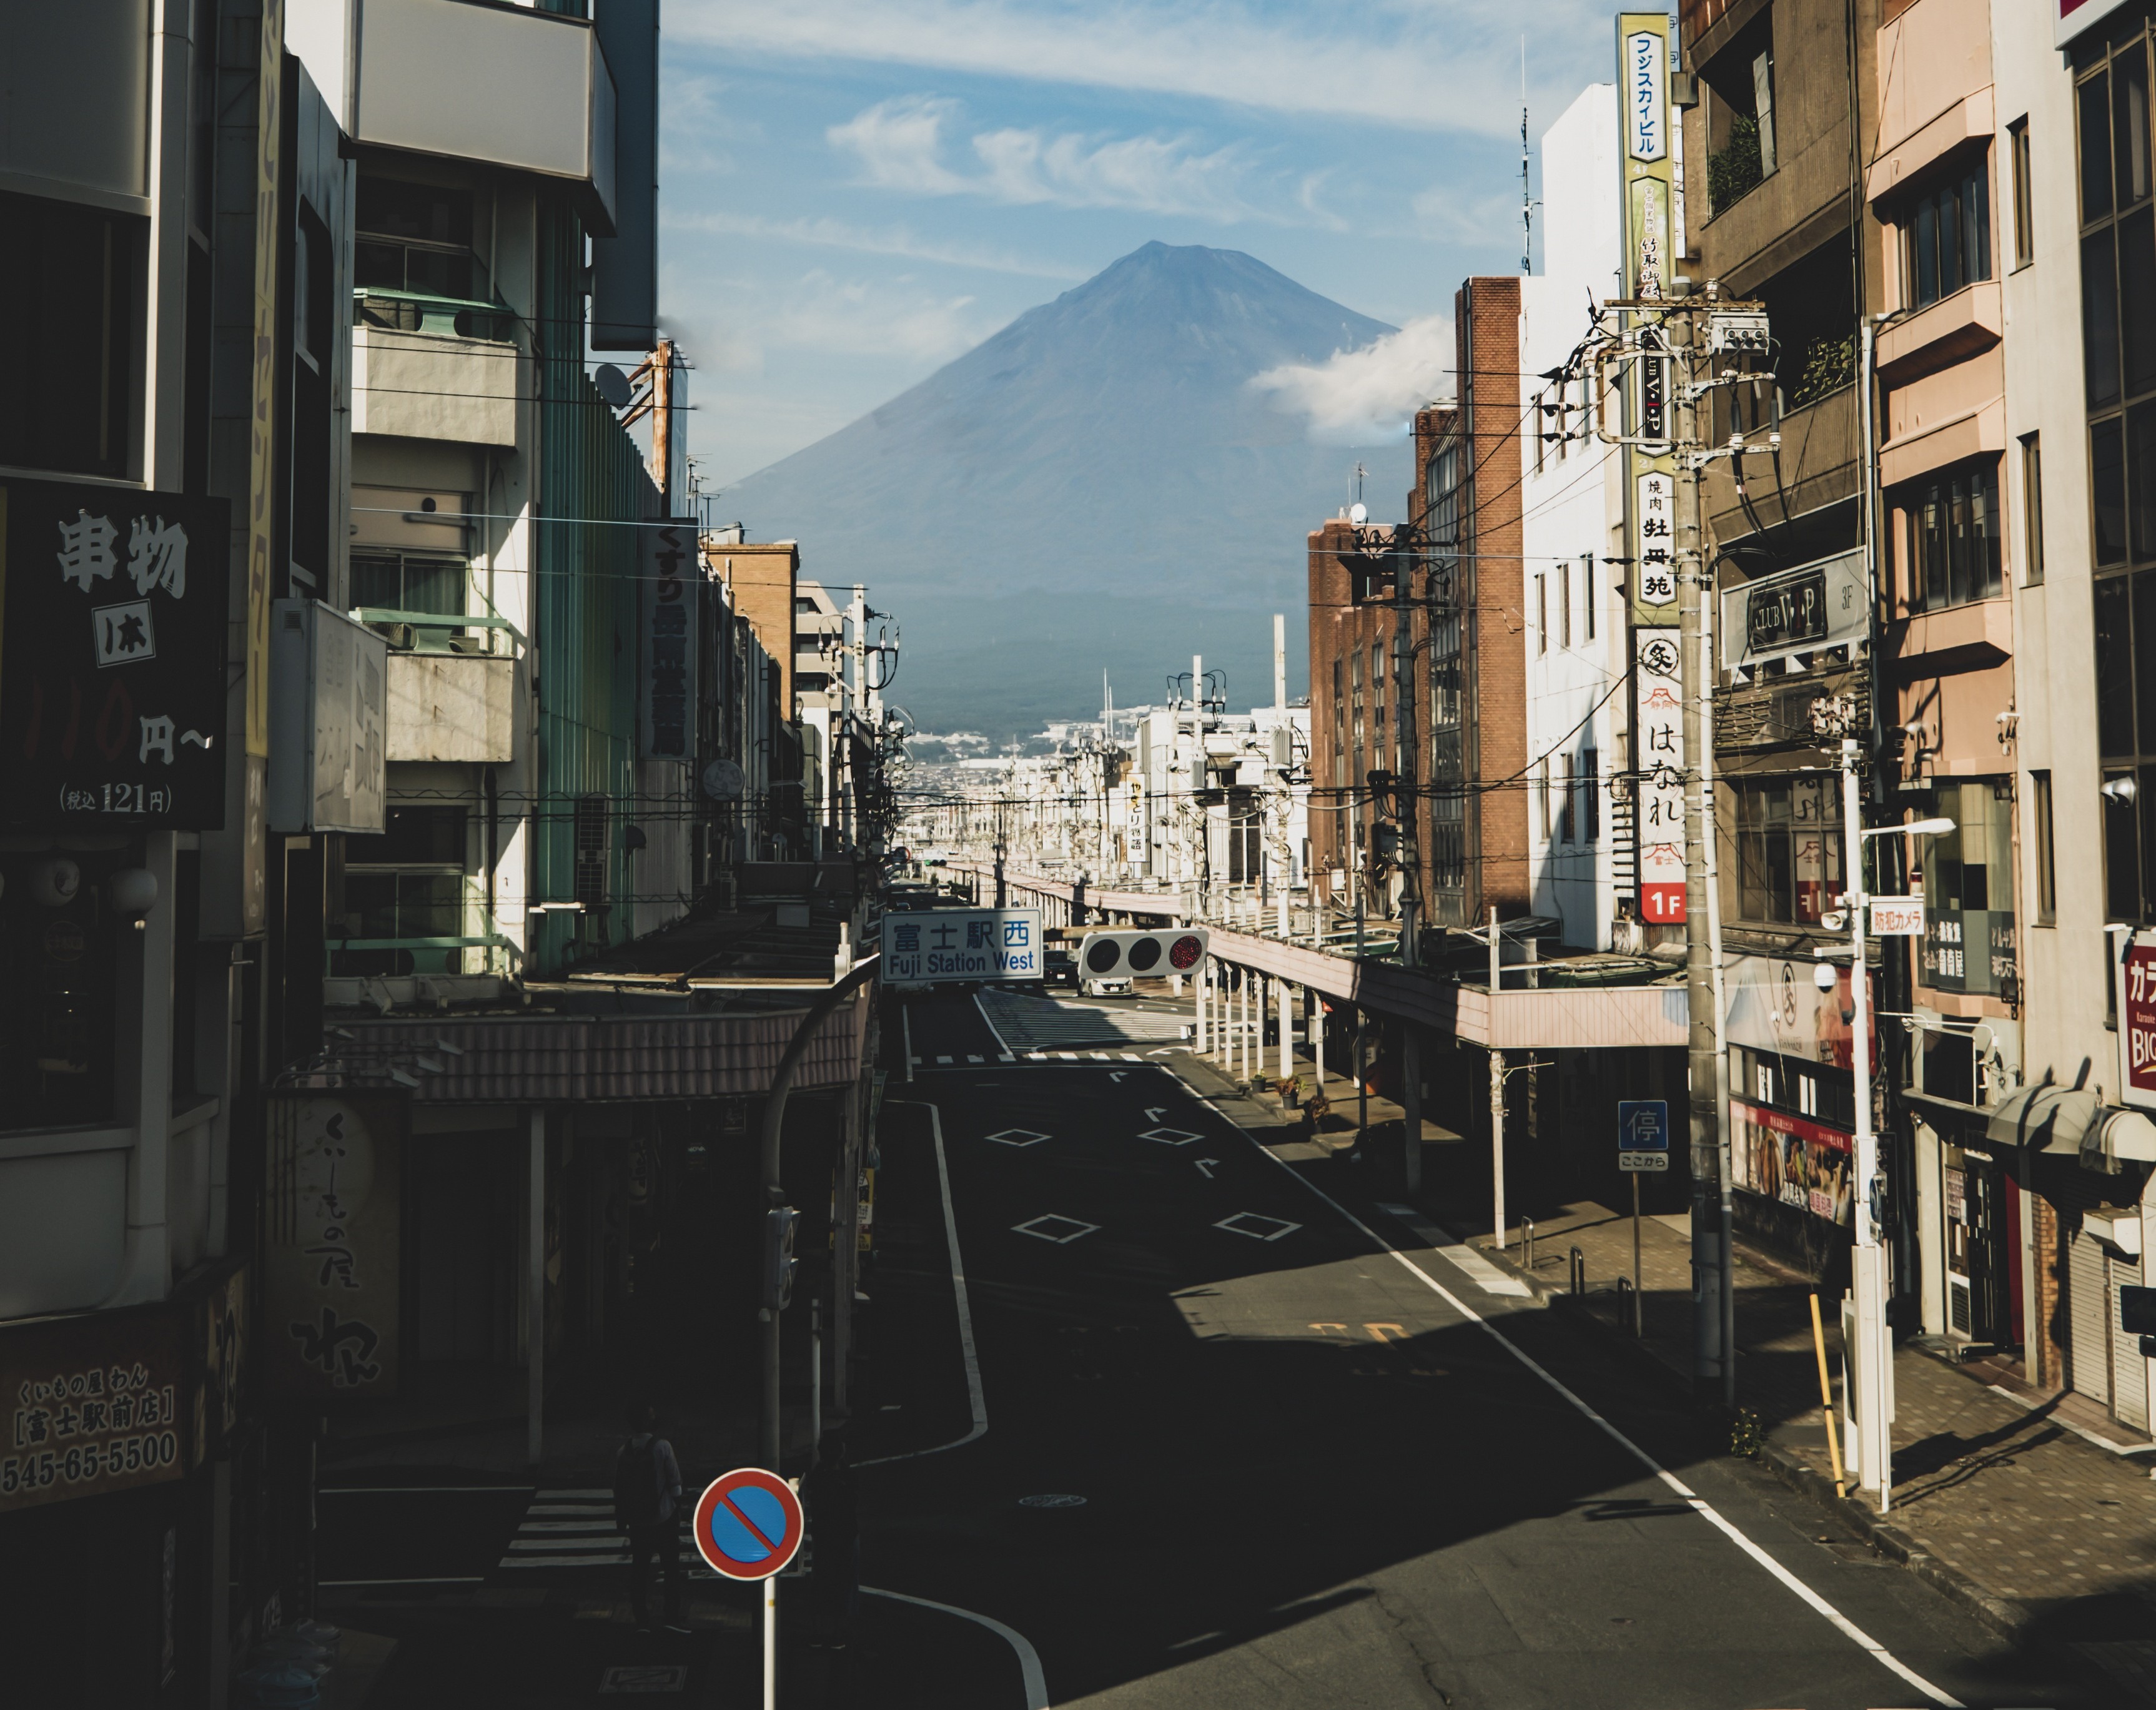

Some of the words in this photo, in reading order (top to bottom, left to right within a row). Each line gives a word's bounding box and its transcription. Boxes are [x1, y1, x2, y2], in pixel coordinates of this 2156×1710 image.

[1636, 39, 1654, 153] フジスカイビル
[1632, 164, 1648, 174] 4F
[1638, 459, 1654, 468] 2F
[1648, 480, 1663, 511] 焼肉
[57, 508, 188, 599] 串物
[1842, 585, 1853, 610] 3F
[104, 613, 147, 655] 1本
[1651, 700, 1672, 710] 静岡
[1649, 723, 1679, 826] はなれ
[1654, 856, 1675, 866] 富士
[1651, 892, 1680, 915] 1F
[893, 920, 1030, 952] 富士駅西
[1874, 911, 1922, 931] 防犯カメラ
[889, 954, 921, 979] Fuji
[927, 952, 985, 974] Station
[993, 950, 1034, 970] West
[1626, 1109, 1659, 1141] 停
[1622, 1155, 1666, 1167] ここから
[19, 1370, 105, 1403] くいもの屋
[110, 1363, 147, 1390] わん
[0, 1432, 175, 1493] 545-65-5500
